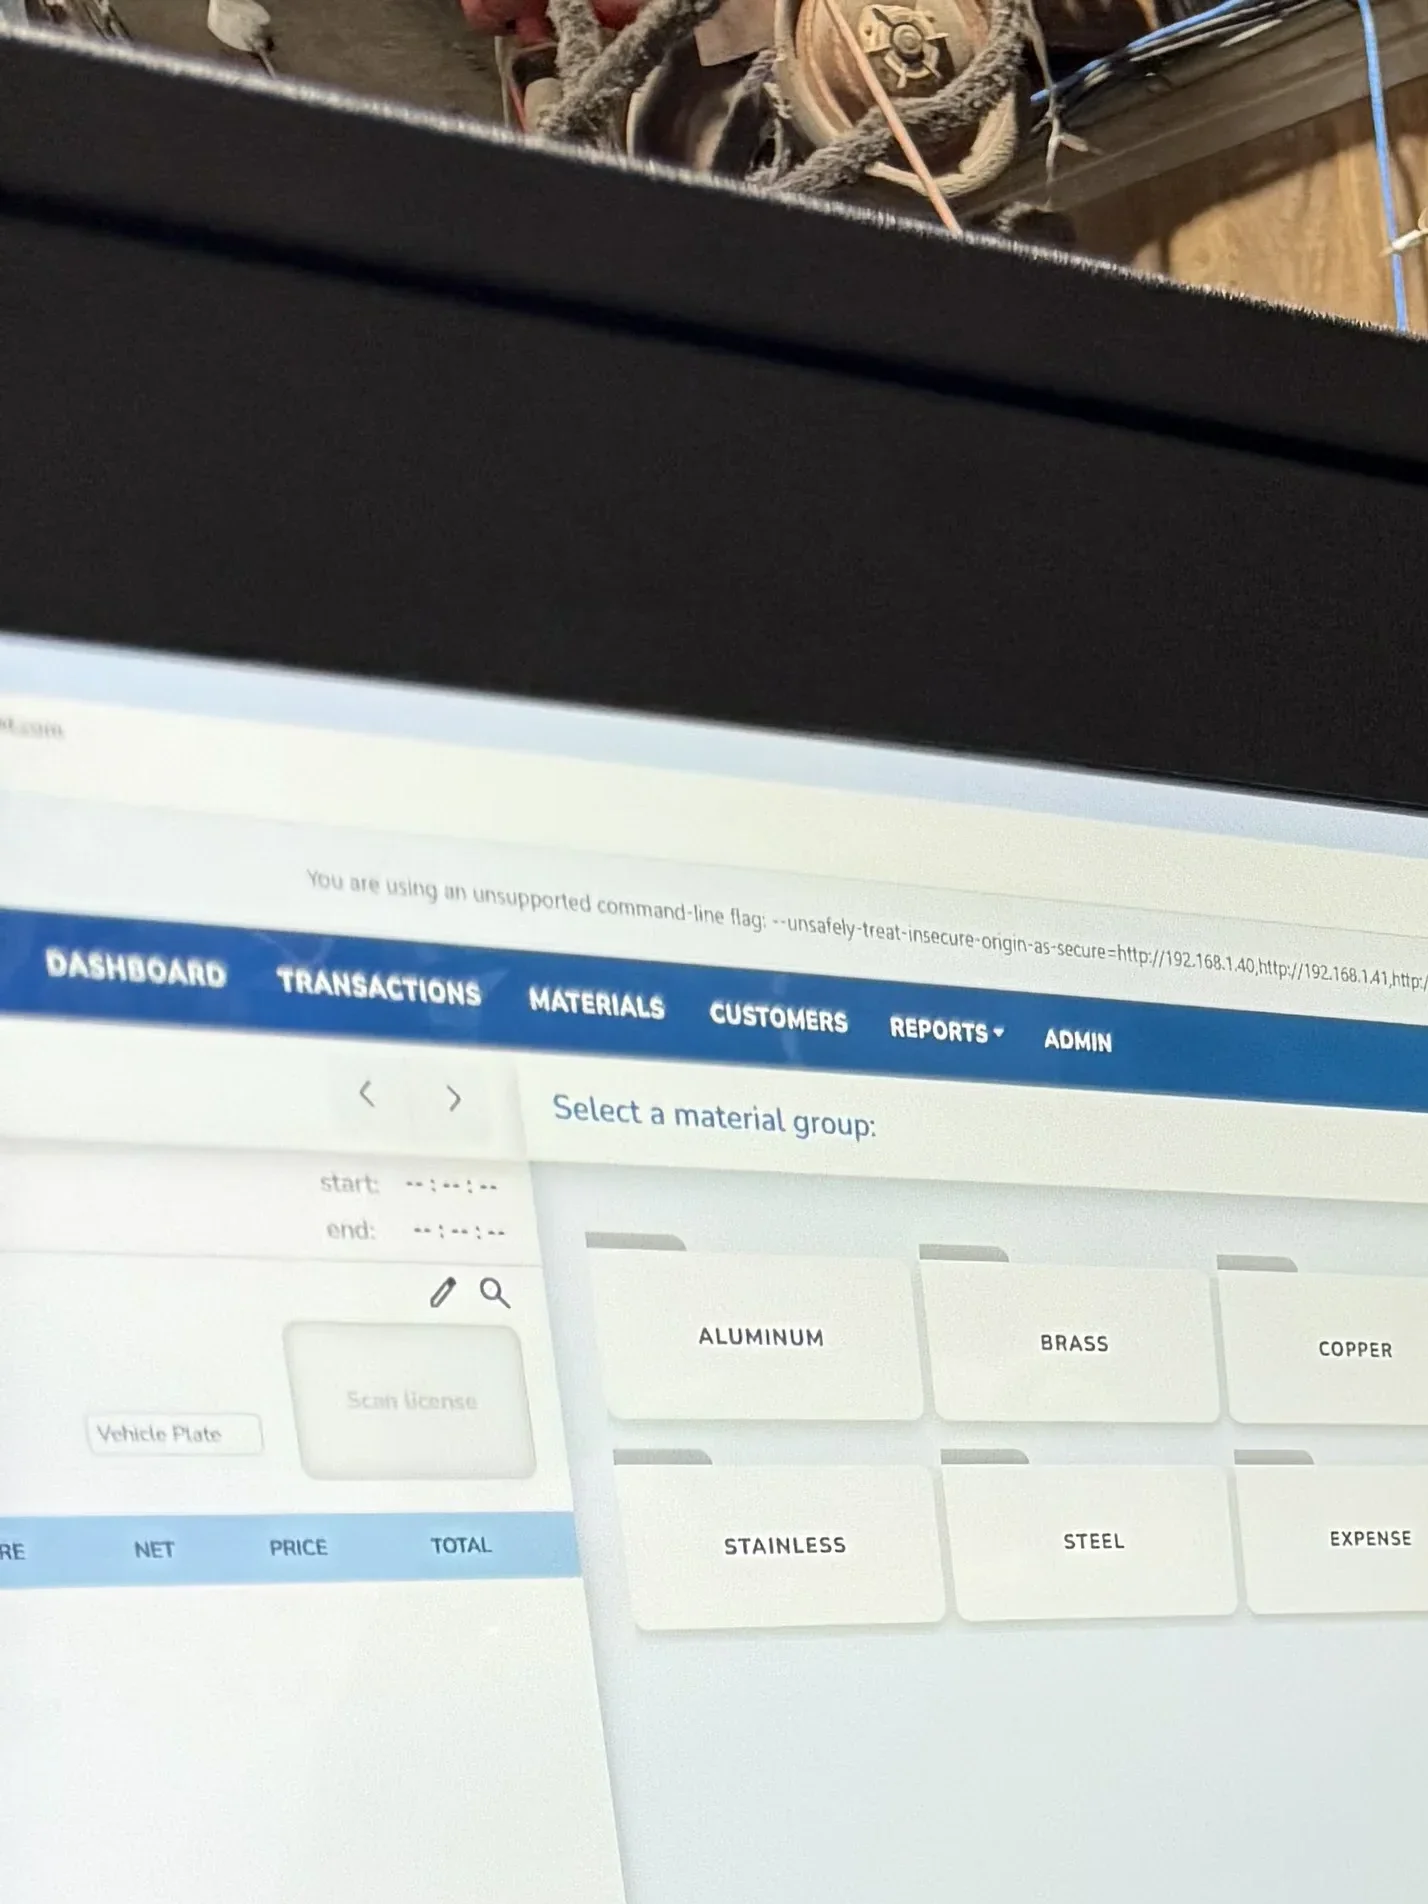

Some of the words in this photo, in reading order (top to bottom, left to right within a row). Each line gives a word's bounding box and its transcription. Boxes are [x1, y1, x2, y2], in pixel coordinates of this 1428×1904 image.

[306, 869, 344, 892] You
[351, 876, 380, 895] are
[386, 878, 438, 905] using
[444, 885, 467, 901] an
[474, 885, 592, 914] unsupported
[597, 896, 724, 926] command-line
[731, 908, 767, 934] flag:
[45, 946, 227, 989] DASHBOARD
[276, 965, 482, 1008] TRANSACTIONS
[528, 985, 666, 1021] MATERIALS
[709, 1000, 849, 1034] CUSTOMERS
[890, 1015, 989, 1044] REPORTS
[1044, 1028, 1113, 1053] ADMIN
[552, 1093, 643, 1127] Select
[651, 1104, 666, 1126] a
[673, 1100, 787, 1139] material
[793, 1111, 877, 1145] group:
[320, 1172, 381, 1195] start:
[327, 1219, 376, 1241] end:
[698, 1327, 825, 1348] ALUMINUM
[1041, 1334, 1109, 1353] BRASS
[1318, 1340, 1393, 1359] COPPER
[347, 1391, 398, 1412] Scan
[404, 1391, 479, 1412] license
[97, 1424, 167, 1444] Vehicle
[172, 1424, 222, 1444] Plate
[134, 1538, 176, 1560] NET
[269, 1537, 329, 1558] PRICE
[431, 1536, 493, 1556] TOTAL
[723, 1535, 848, 1556] STAINLESS
[1062, 1532, 1125, 1552] STEEL
[1329, 1529, 1412, 1548] EXPENSE
